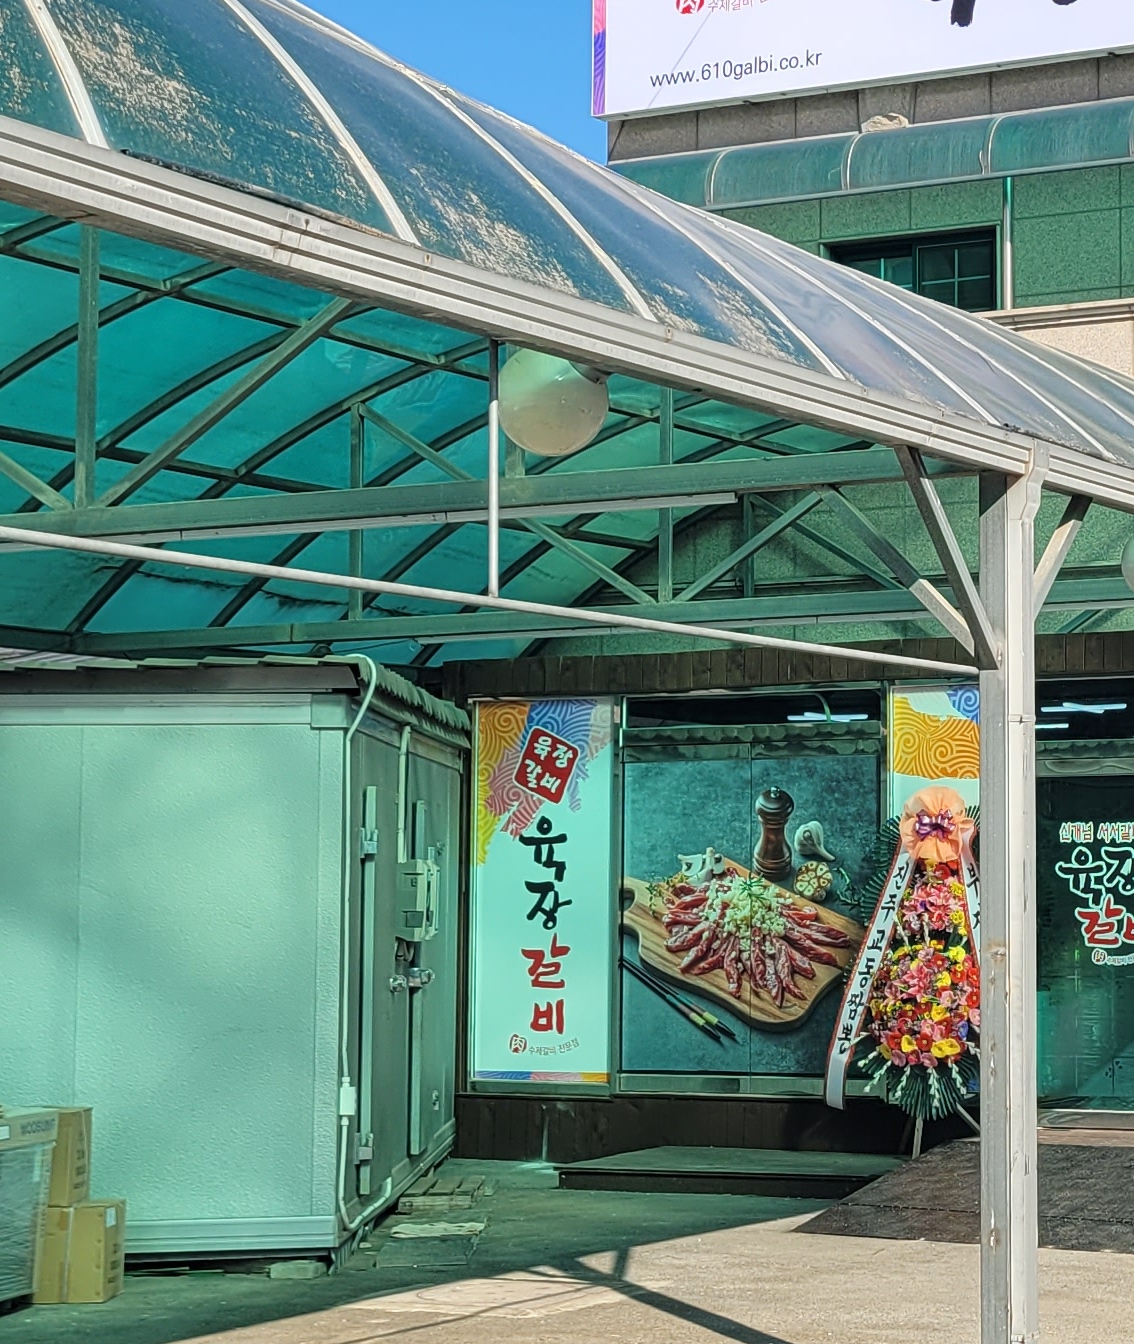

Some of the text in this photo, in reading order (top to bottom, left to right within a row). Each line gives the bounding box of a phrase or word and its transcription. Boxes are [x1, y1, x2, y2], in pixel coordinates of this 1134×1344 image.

[649, 49, 823, 88] www.610galbi.co.kr
[533, 735, 574, 769] 육장
[524, 758, 562, 794] 갈비
[1060, 821, 1094, 843] 신개념
[519, 815, 573, 1035] 육장갈비
